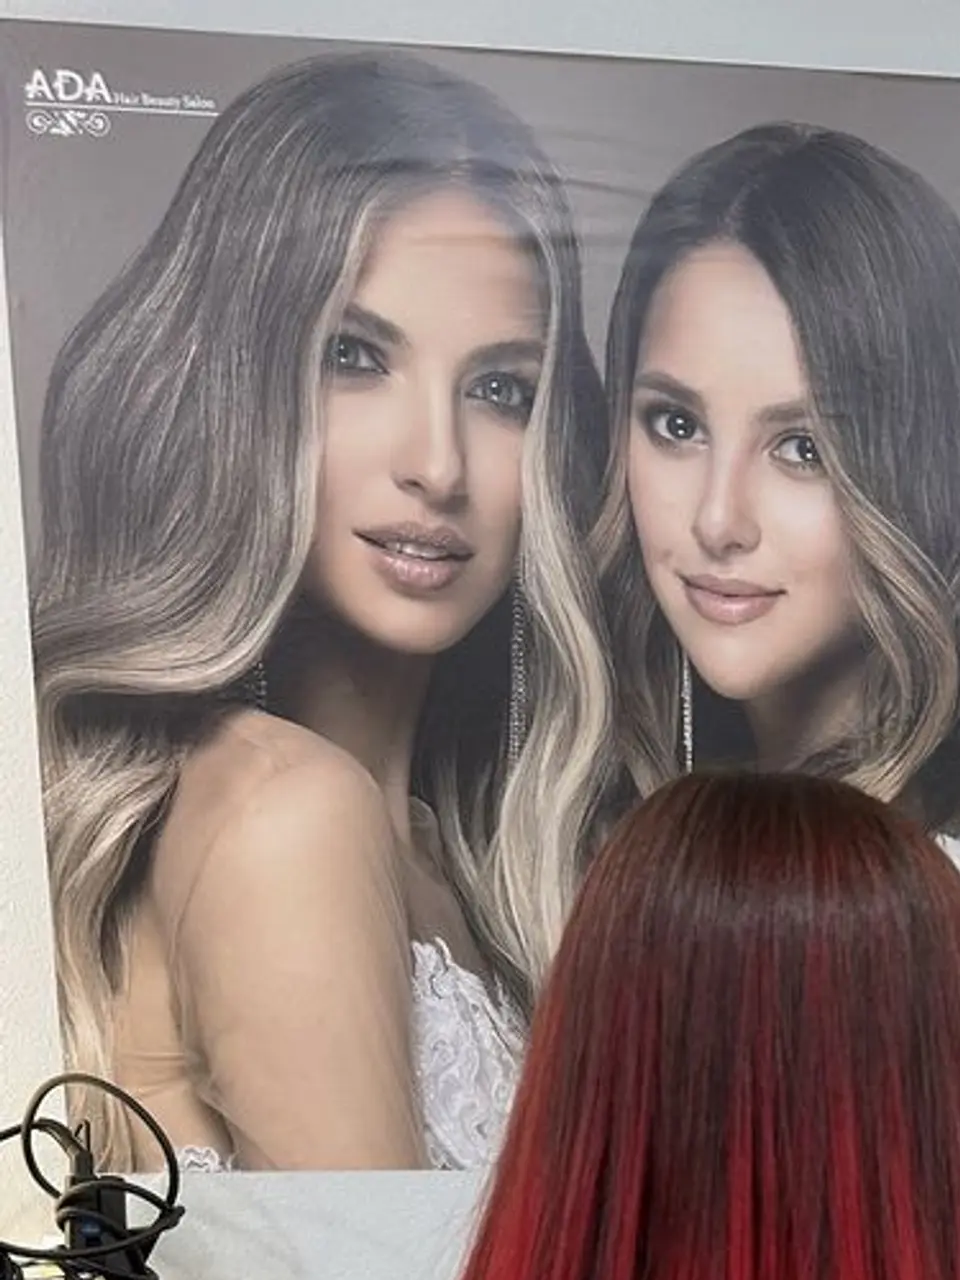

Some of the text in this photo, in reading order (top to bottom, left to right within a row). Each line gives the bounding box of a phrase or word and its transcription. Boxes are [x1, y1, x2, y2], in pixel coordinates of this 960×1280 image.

[25, 69, 216, 109] ADA Hair Beauty Salon
